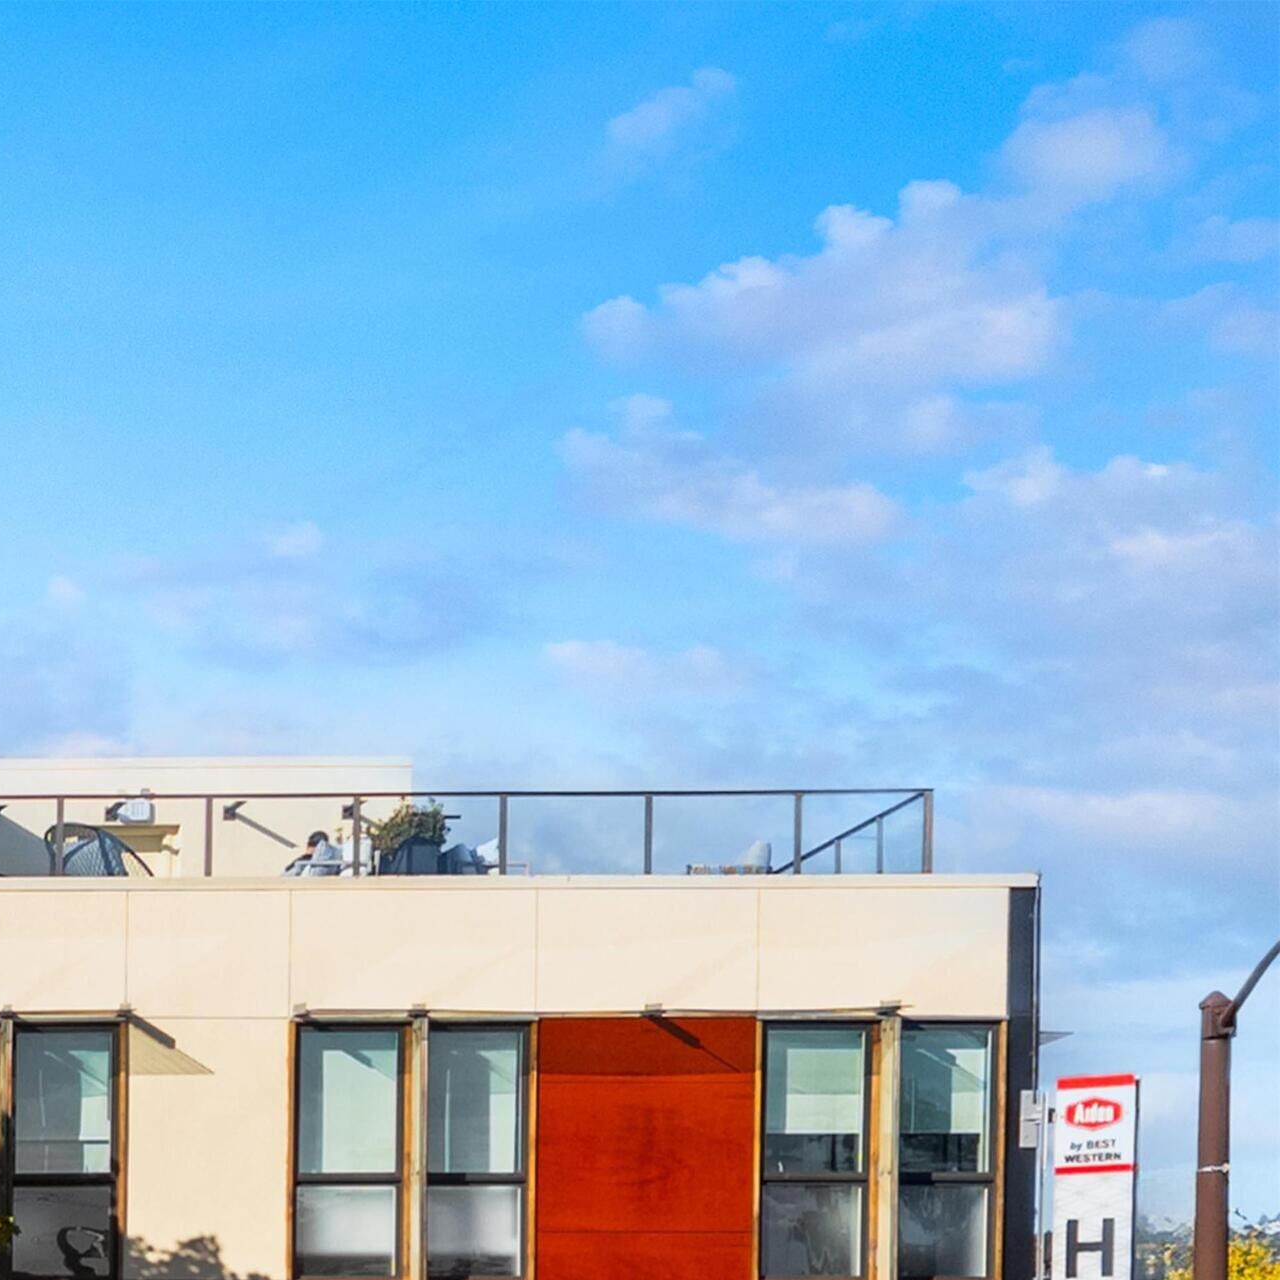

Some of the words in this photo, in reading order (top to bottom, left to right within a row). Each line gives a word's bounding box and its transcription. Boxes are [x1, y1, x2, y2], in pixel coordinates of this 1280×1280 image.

[1070, 1142, 1083, 1151] by
[1086, 1139, 1116, 1149] BEST
[1064, 1152, 1121, 1163] WESTERN
